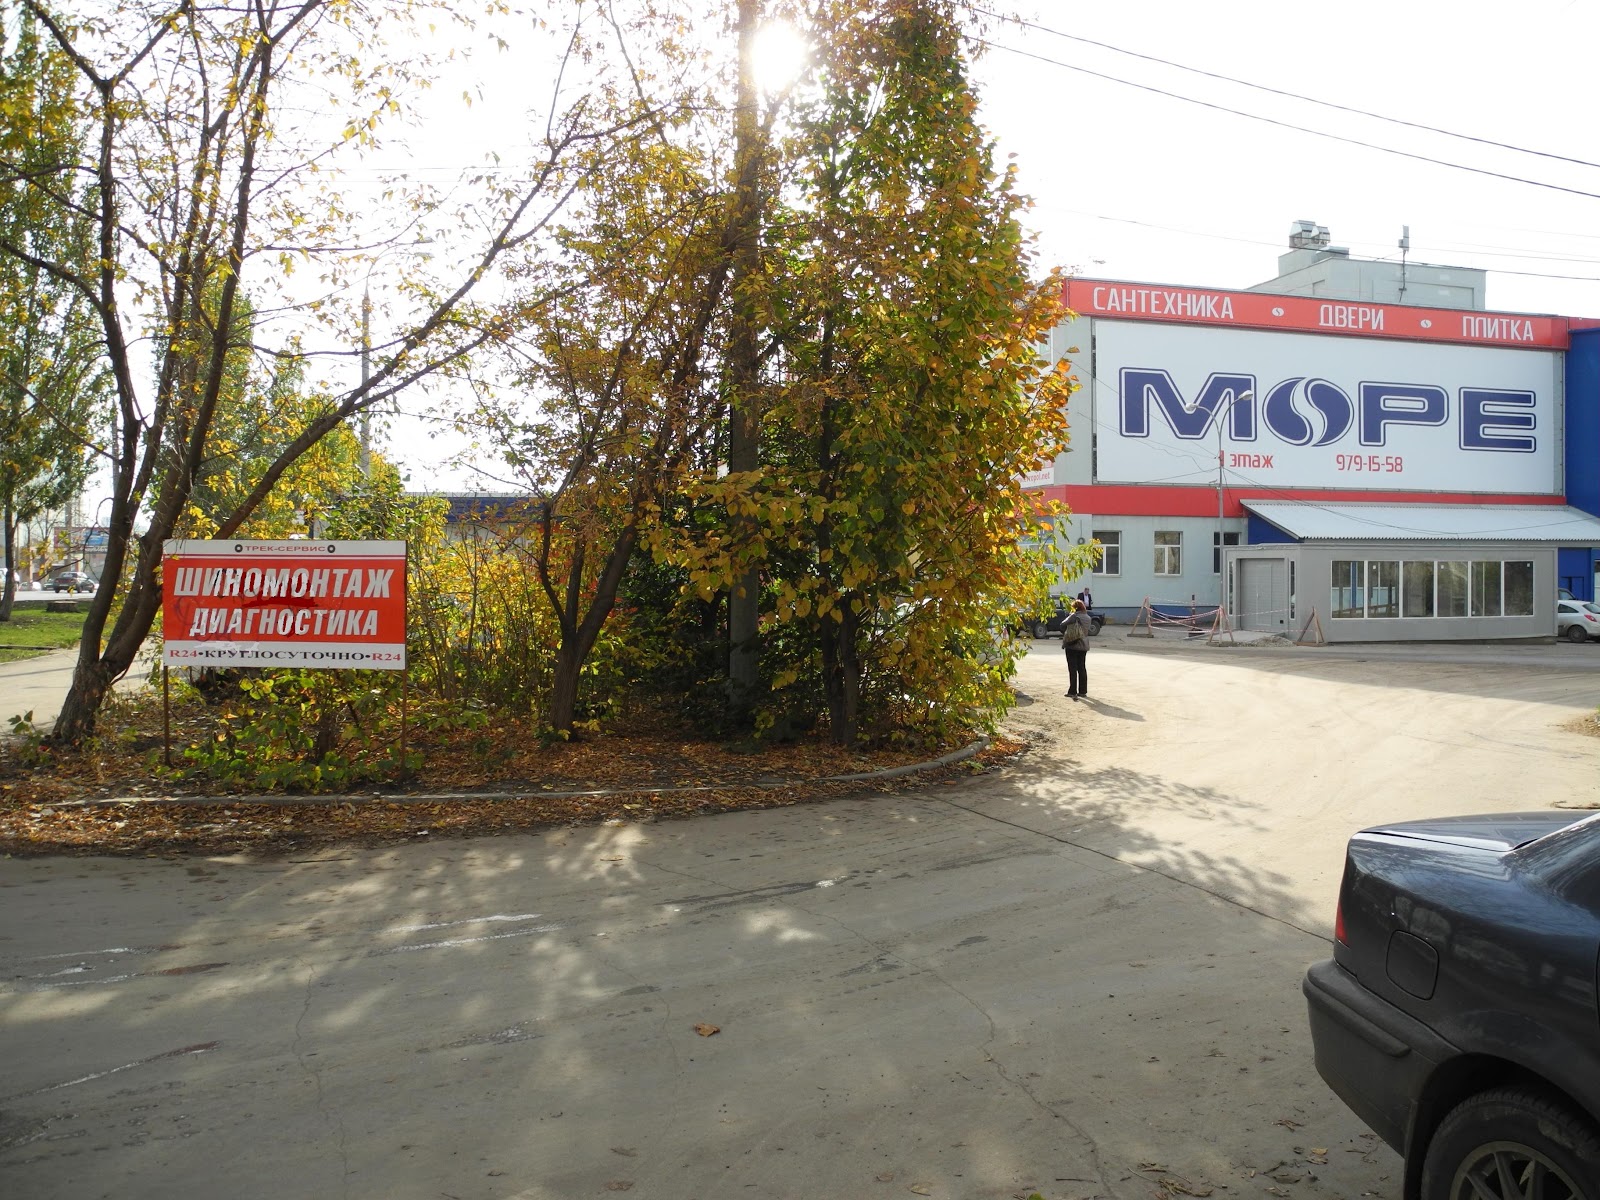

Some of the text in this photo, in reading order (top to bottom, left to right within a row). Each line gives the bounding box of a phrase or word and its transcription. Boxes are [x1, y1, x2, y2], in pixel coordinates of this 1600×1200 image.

[1093, 286, 1534, 341] САНТЕХНИКА ДВЕРИ ПЛИТКА
[1119, 366, 1536, 454] МОРЕ
[1229, 453, 1274, 469] этаж
[1336, 454, 1403, 473] 979-15-58
[173, 566, 394, 599] ШИНОМОНТАЖ
[189, 607, 379, 637] ДИАГНОСТИКА
